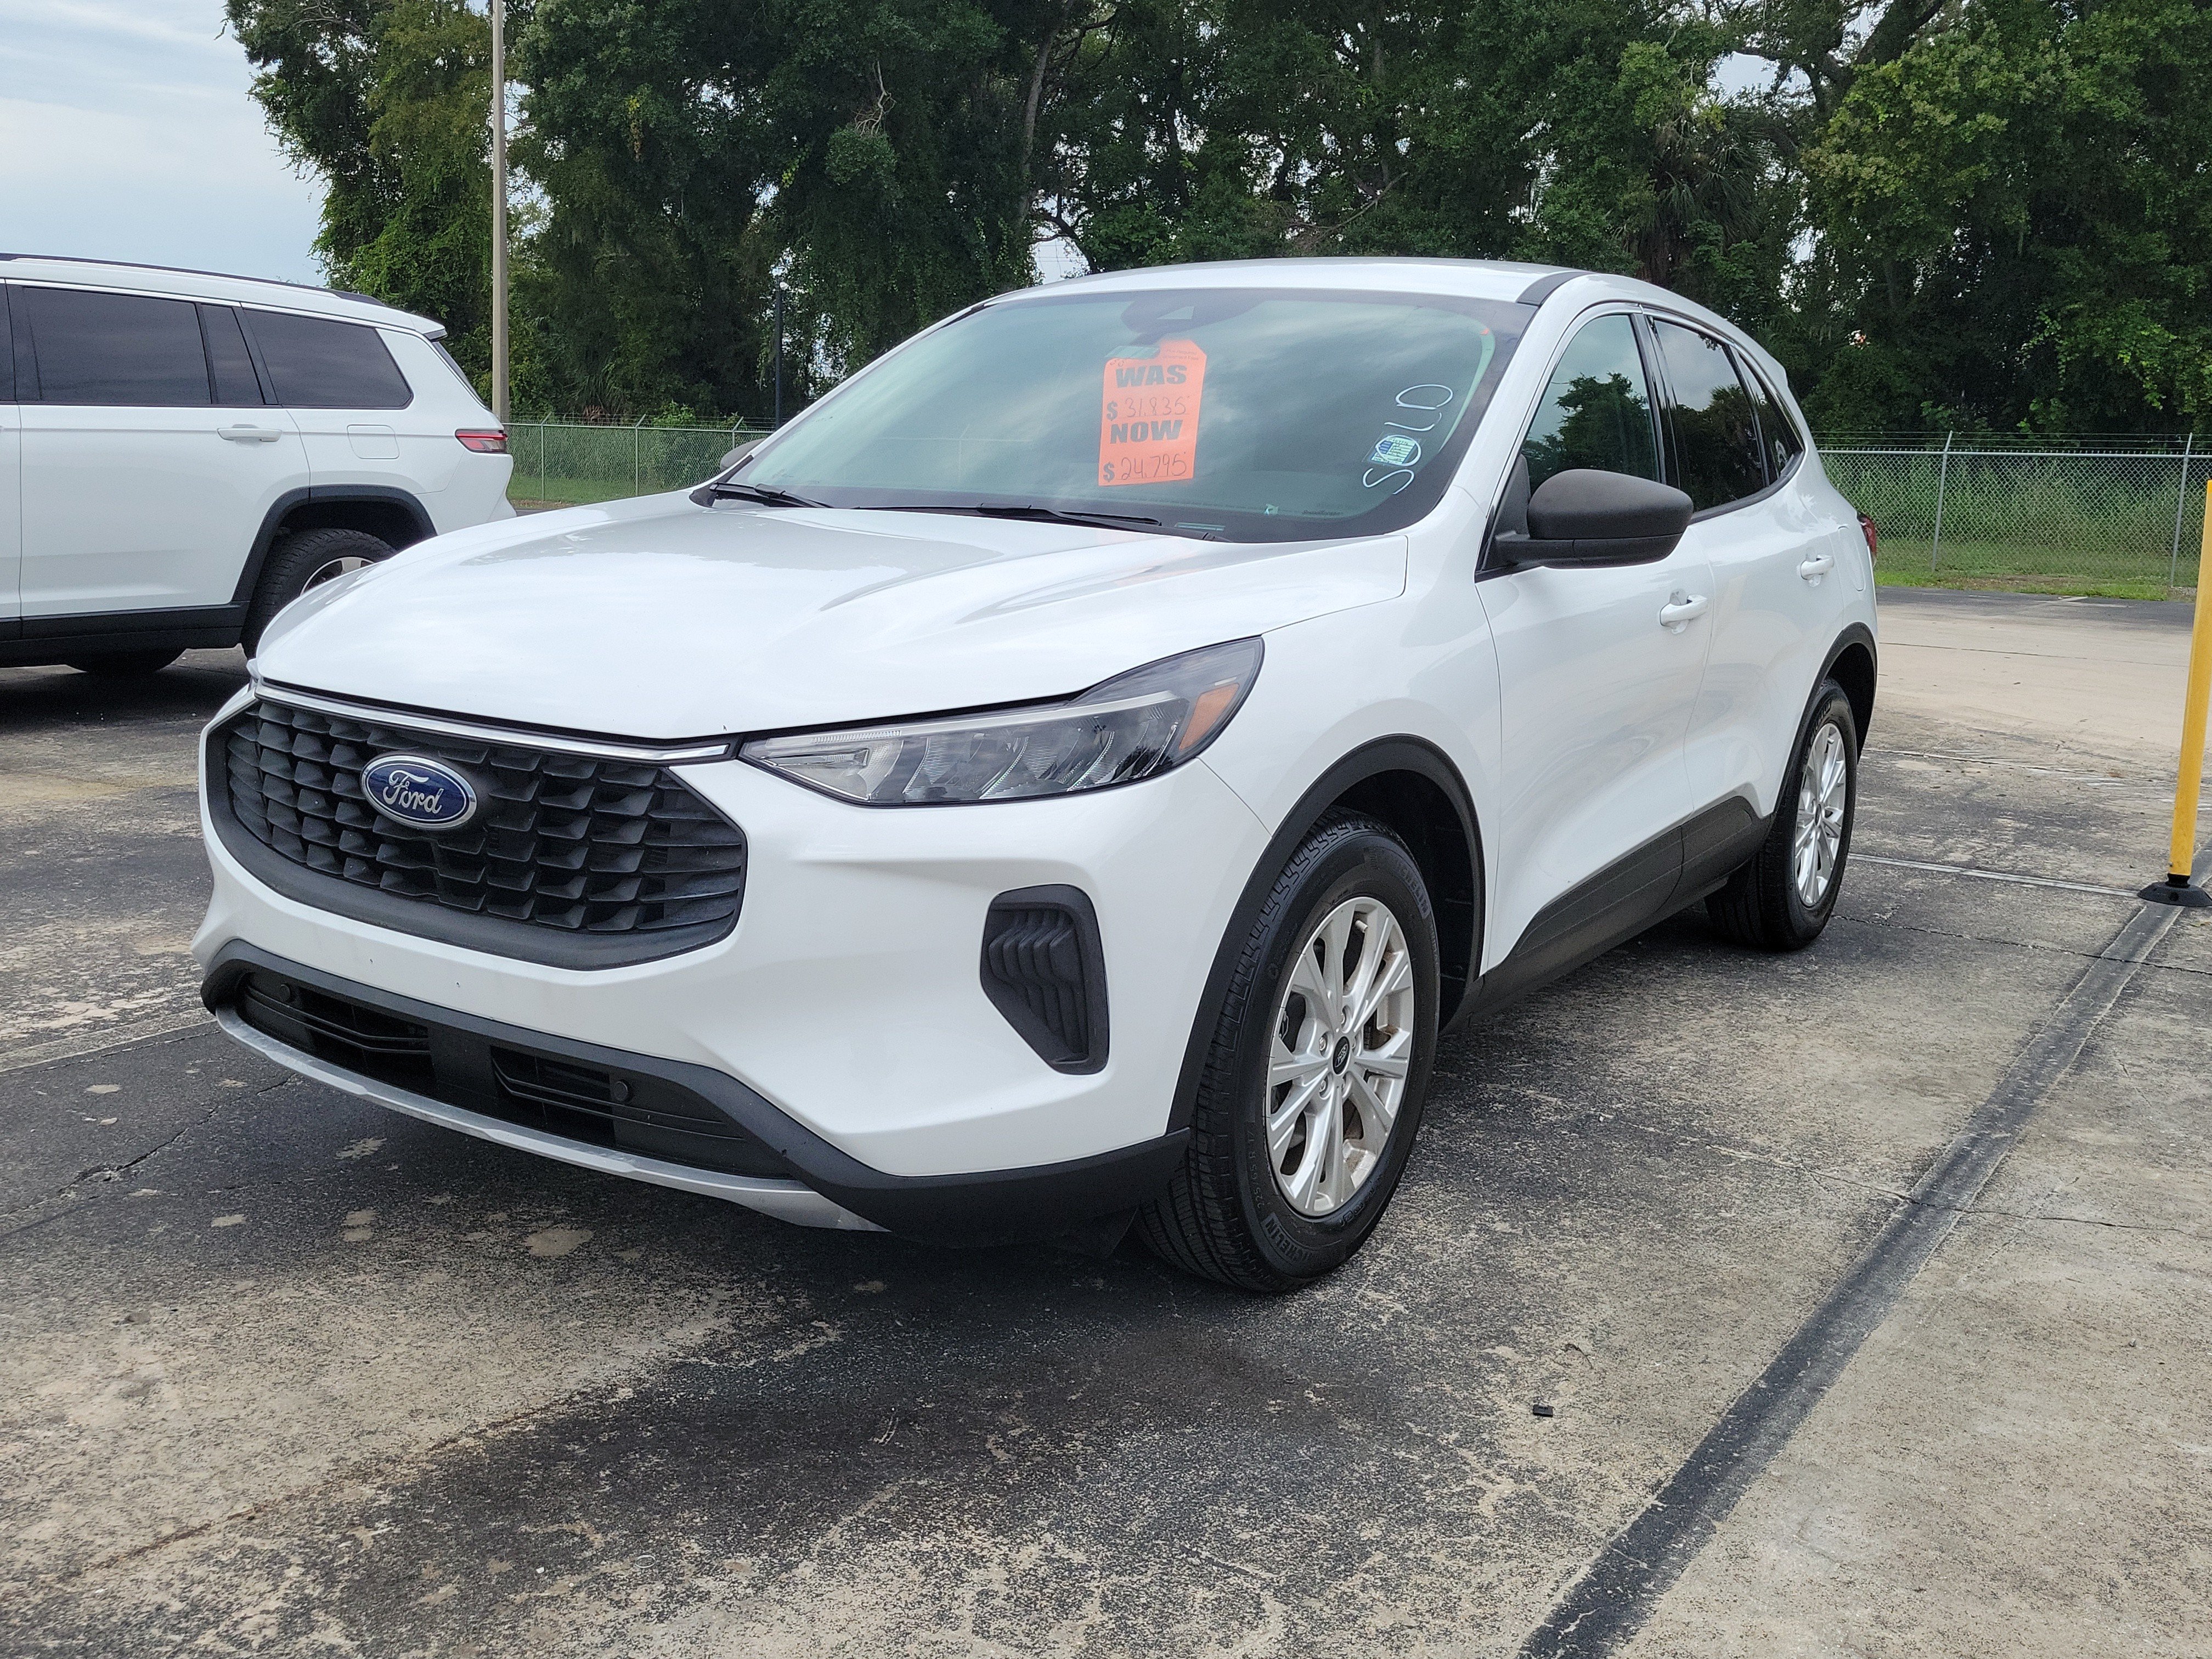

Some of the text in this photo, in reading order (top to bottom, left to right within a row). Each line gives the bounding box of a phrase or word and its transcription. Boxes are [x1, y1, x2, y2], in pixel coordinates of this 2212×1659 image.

[1116, 364, 1187, 388] WAS
[1107, 401, 1118, 421] $
[1110, 420, 1183, 444] NOW
[1362, 384, 1453, 494] SOLD
[1103, 462, 1115, 482] $
[383, 770, 444, 814] Ford
[1265, 1218, 1317, 1262] ICHELIN
